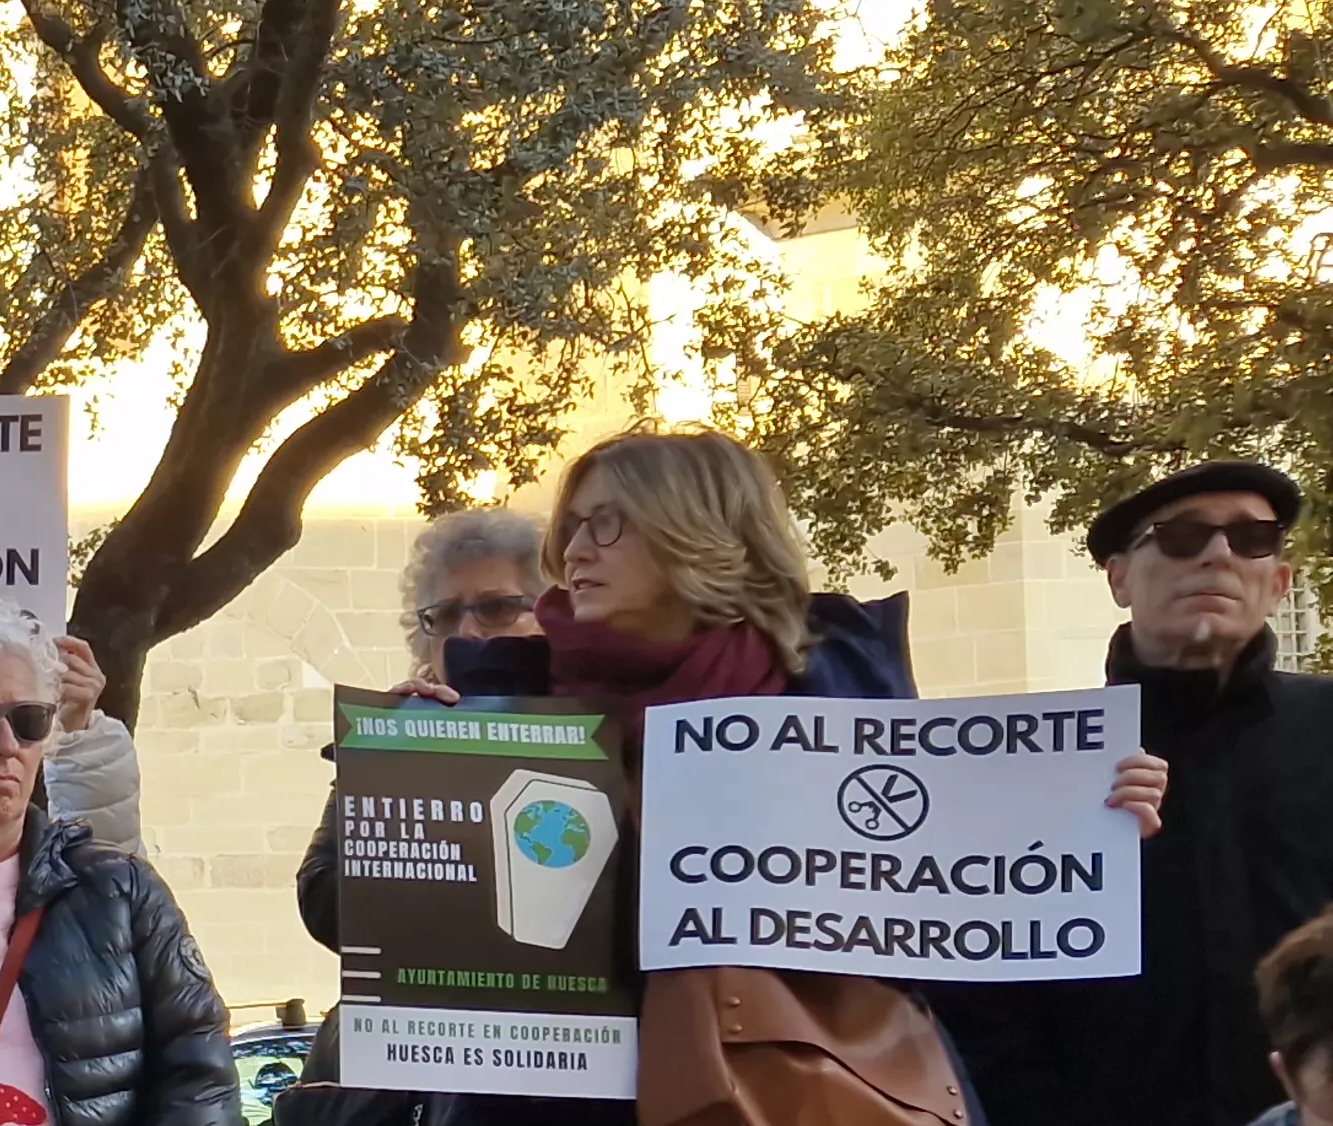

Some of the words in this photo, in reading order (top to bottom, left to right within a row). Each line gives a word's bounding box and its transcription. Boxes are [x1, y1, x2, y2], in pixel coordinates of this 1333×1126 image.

[356, 717, 398, 736] ¡NOS
[405, 719, 481, 740] QUIEREN
[487, 722, 586, 745] ENTERRAR!
[674, 714, 760, 753] NO
[769, 715, 839, 753] AL
[853, 708, 1105, 757] RECORTE
[344, 795, 483, 823] ENTIERRO
[344, 820, 386, 838] POR
[401, 822, 425, 840] LA
[344, 839, 461, 861] COOPERACIÓN
[344, 859, 477, 882] INTERNACIONAL
[669, 839, 1103, 896] COOPERACIÓN
[668, 907, 738, 947] AL
[750, 907, 1106, 961] DESARROLLO
[397, 967, 515, 989] AYUNTAMIENTO
[521, 973, 541, 990] DE
[547, 974, 608, 993] HUESCA
[353, 1017, 373, 1033] NO
[382, 1019, 399, 1035] AL
[407, 1020, 475, 1038] RECORTE
[483, 1024, 501, 1039] EN
[510, 1025, 622, 1044] COOPERACIÓN
[387, 1043, 455, 1065] HUESCA
[463, 1047, 484, 1066] ES
[492, 1049, 588, 1071] SOLIDARIA
